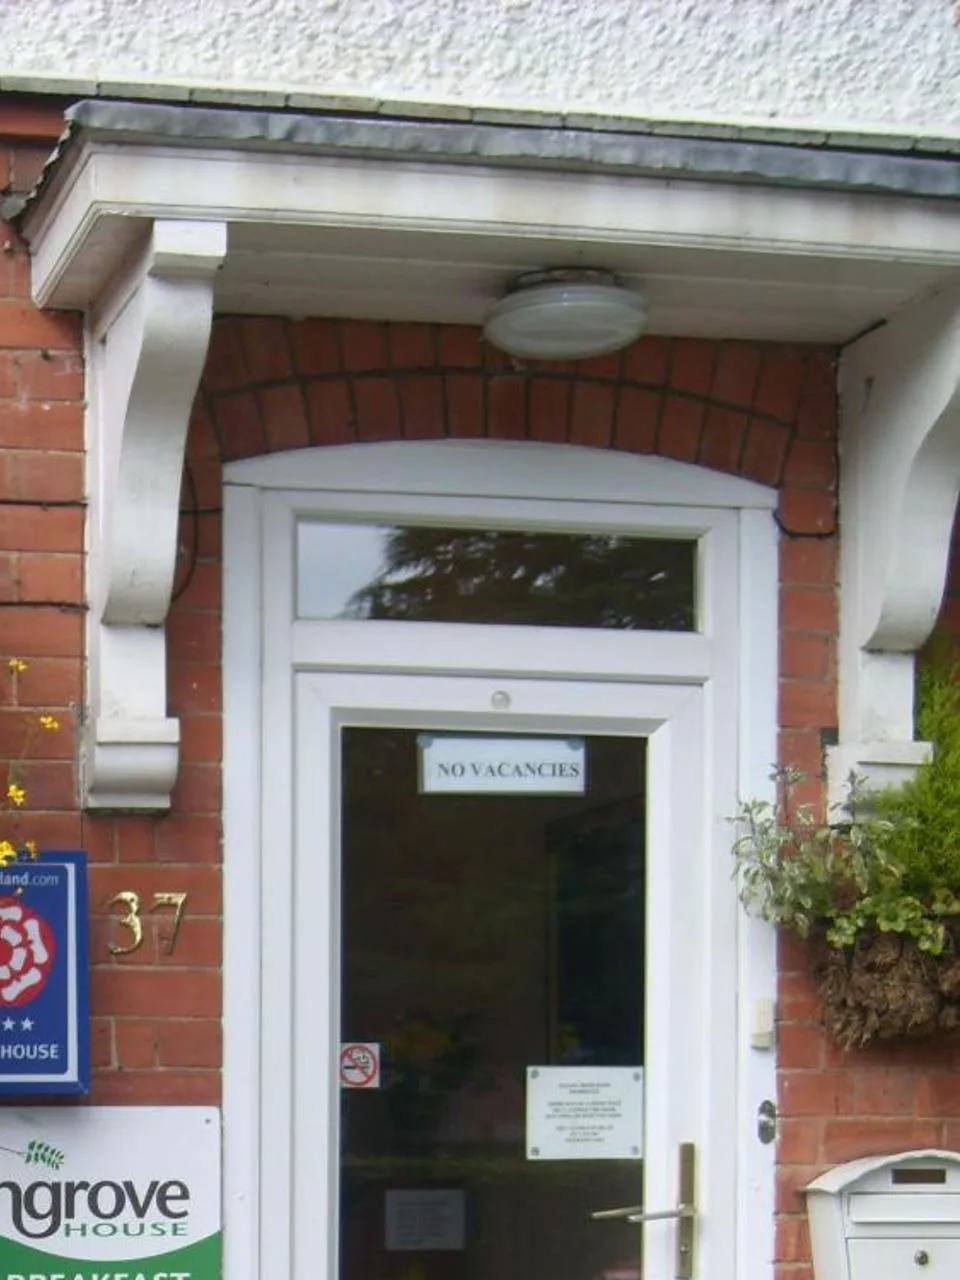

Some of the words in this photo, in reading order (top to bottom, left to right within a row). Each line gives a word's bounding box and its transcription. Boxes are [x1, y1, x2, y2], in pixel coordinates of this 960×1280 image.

[438, 762, 465, 778] NO
[471, 762, 580, 779] VACANCIES
[106, 890, 188, 956] 37
[0, 1043, 60, 1060] HOUSE
[64, 1222, 188, 1238] HOUSE
